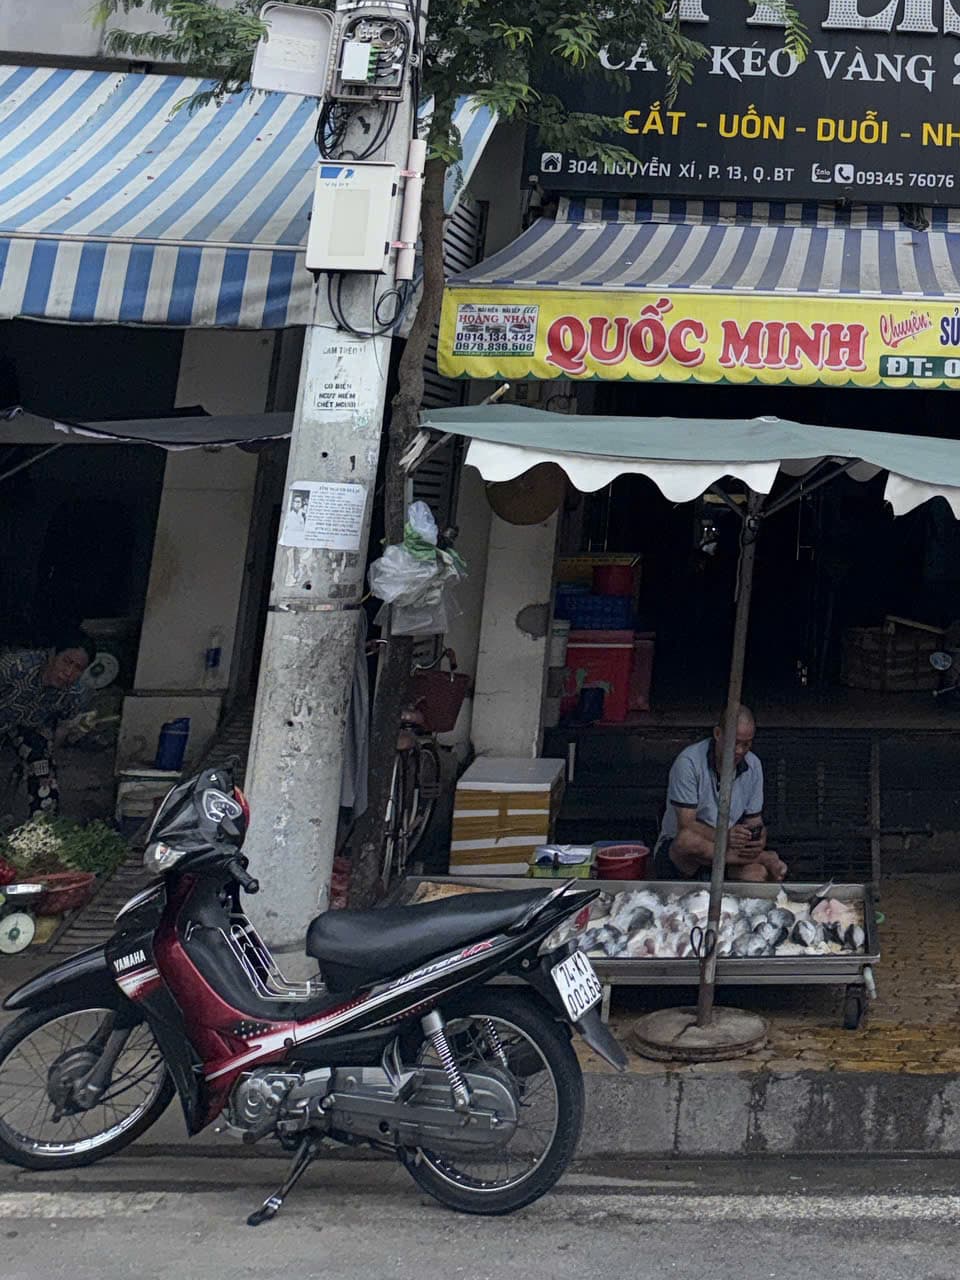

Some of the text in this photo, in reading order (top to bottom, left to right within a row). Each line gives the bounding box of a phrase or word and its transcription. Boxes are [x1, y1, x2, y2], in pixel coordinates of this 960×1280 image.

[708, 41, 799, 82] KÉO
[814, 46, 936, 93] VÀNG
[623, 100, 686, 136] CẮT
[719, 104, 785, 140] UỐN
[816, 110, 889, 145] DUỖI
[567, 159, 598, 175] 304
[603, 156, 672, 178] NGUYỄN
[856, 171, 904, 187] 09345
[908, 173, 955, 188] 76076
[545, 297, 868, 375] QUỐC MINH
[886, 356, 933, 377] ĐT:
[113, 949, 146, 973] YAMAHA
